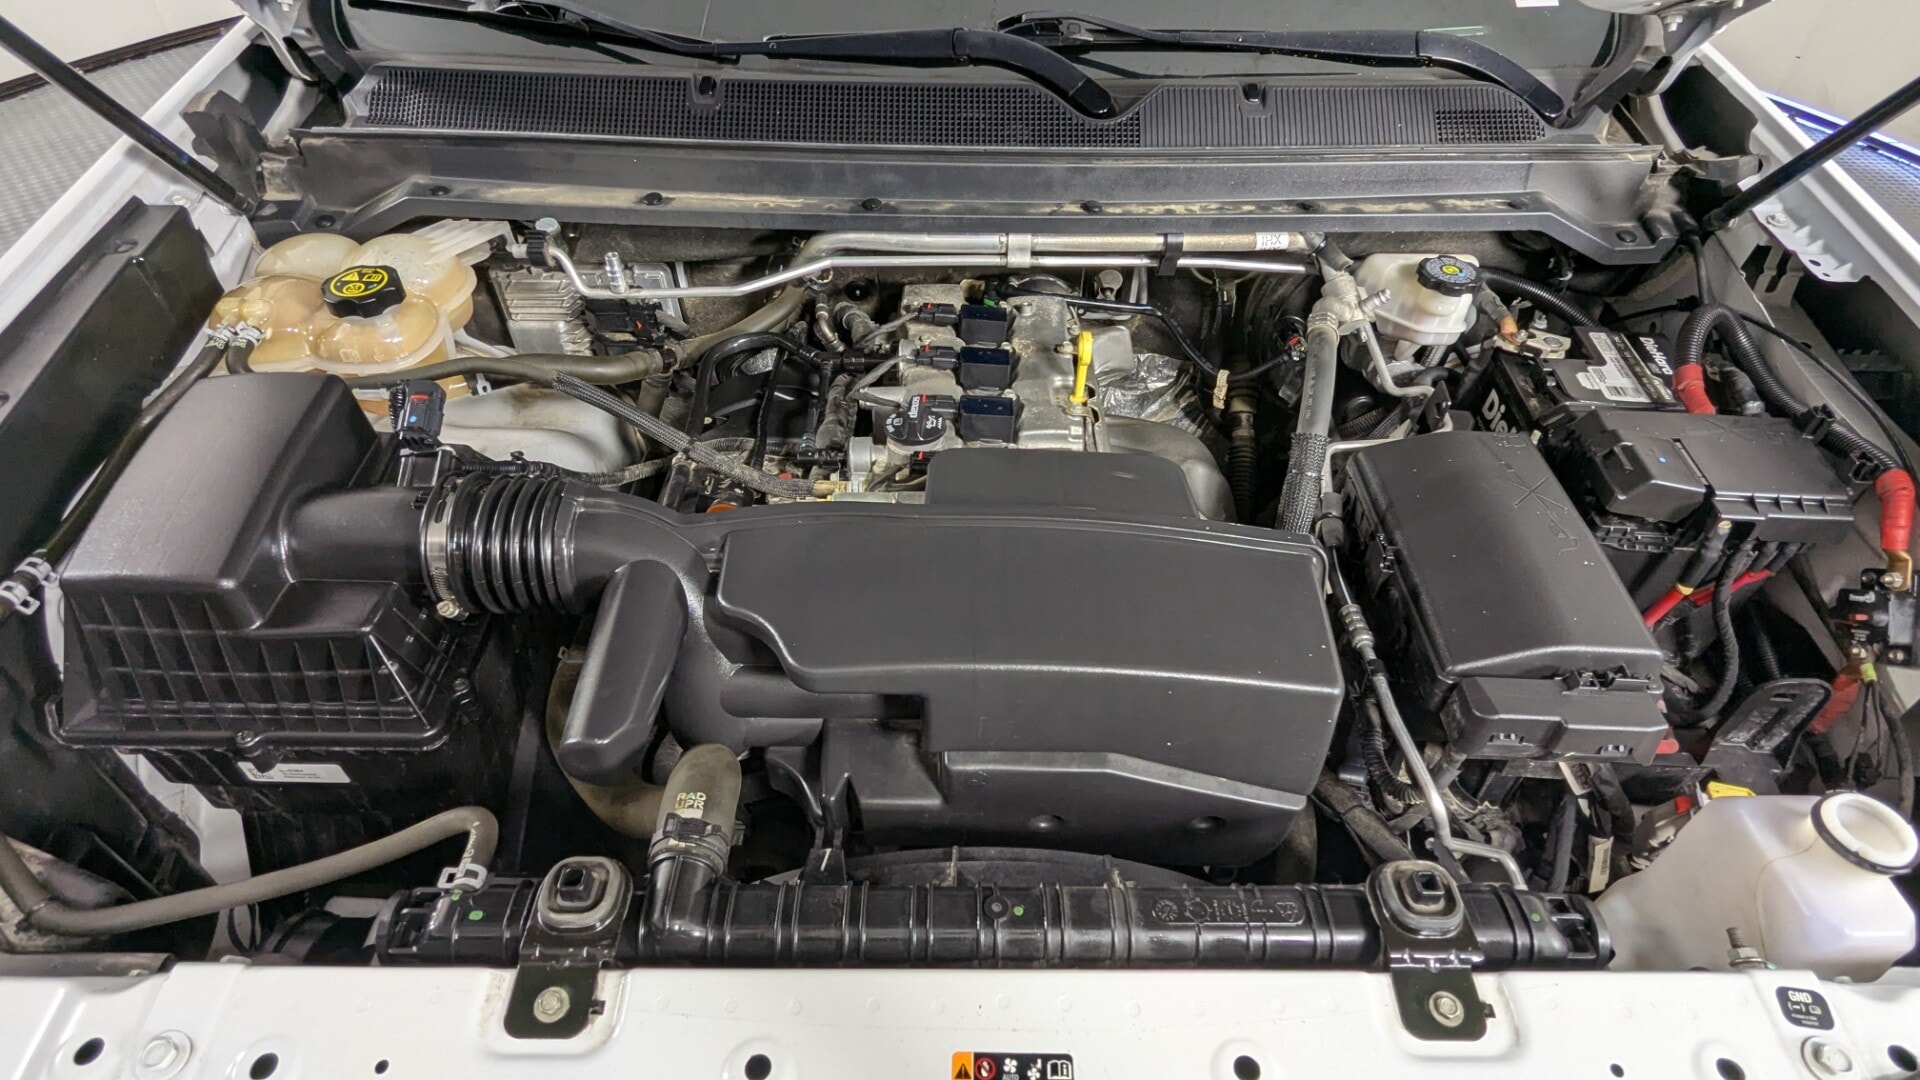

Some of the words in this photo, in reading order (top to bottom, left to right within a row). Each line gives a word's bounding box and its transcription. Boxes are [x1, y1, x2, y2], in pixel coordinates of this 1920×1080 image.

[1639, 336, 1674, 375] DieHard
[1481, 387, 1518, 433] Die
[676, 791, 707, 801] RAD
[674, 799, 705, 810] UPR
[1788, 990, 1813, 1004] GND
